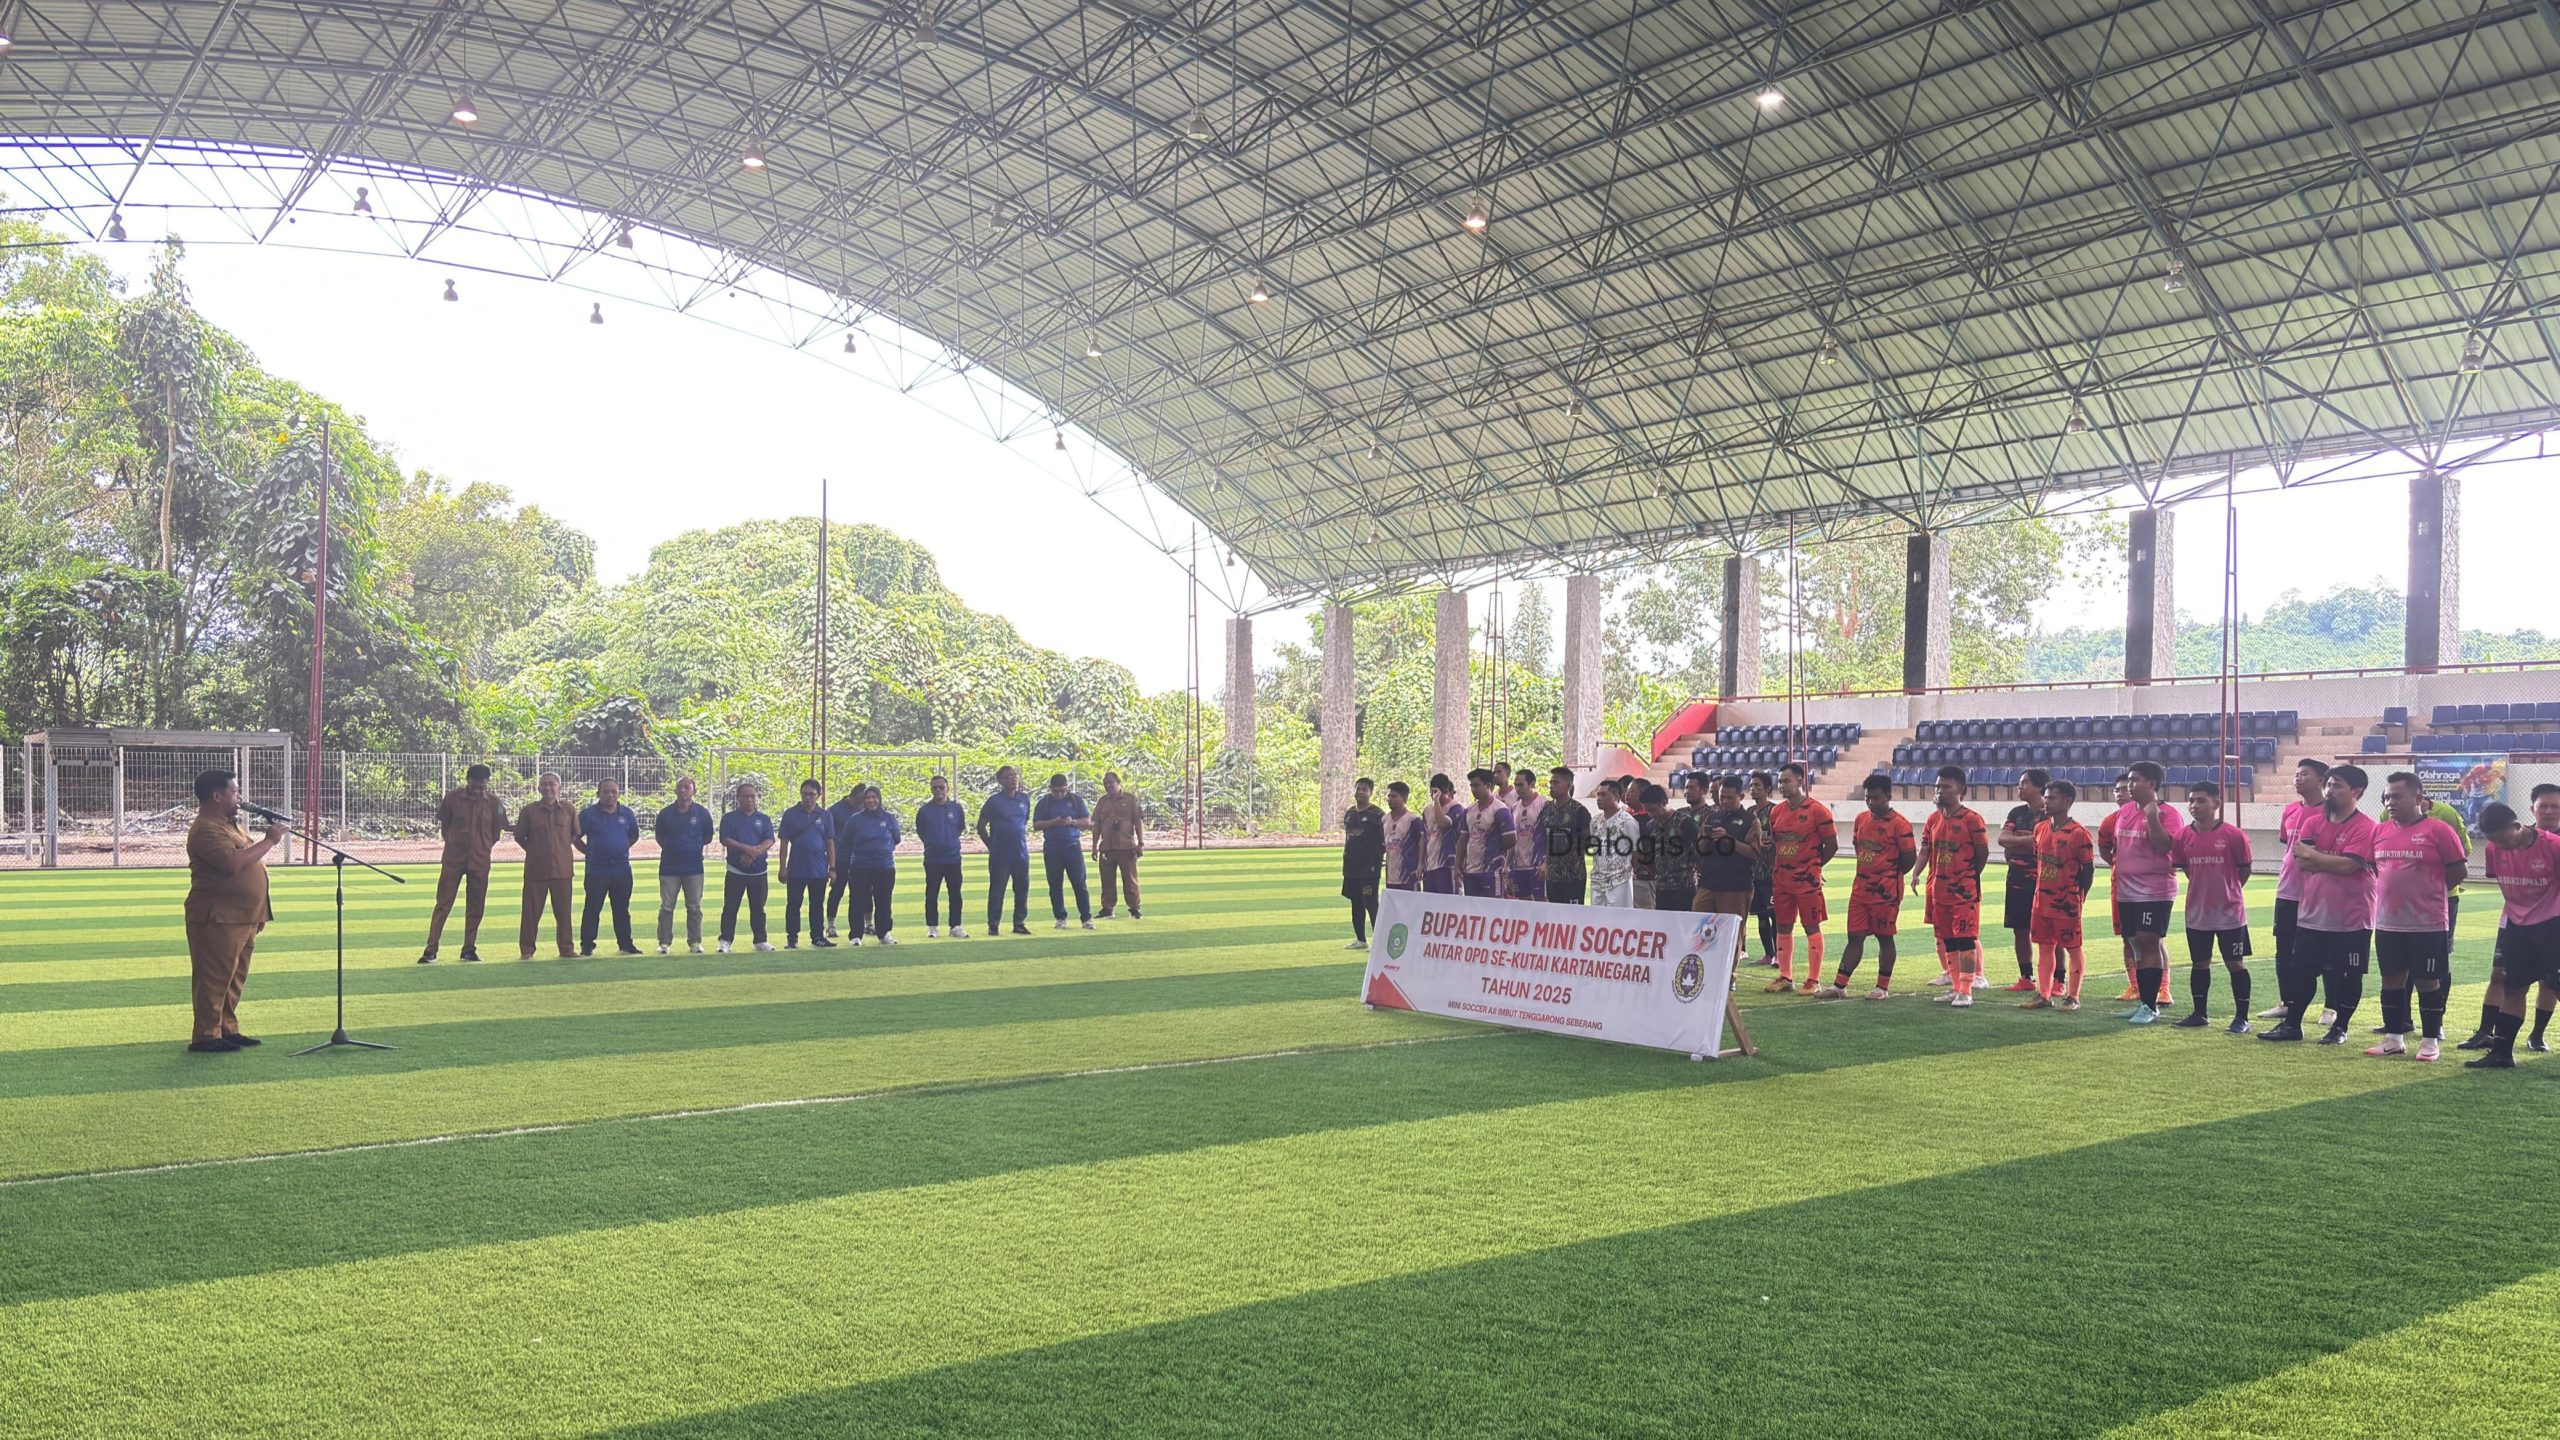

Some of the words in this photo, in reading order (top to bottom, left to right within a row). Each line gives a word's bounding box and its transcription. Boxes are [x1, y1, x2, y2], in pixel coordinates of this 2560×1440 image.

[2418, 770, 2461, 782] Olahraga
[2141, 911, 2153, 926] 15
[1420, 910, 1487, 942] BUPATI
[1488, 916, 1529, 945] CUP
[1531, 920, 1578, 951] MINI
[1579, 926, 1668, 960] SOCCER
[2060, 929, 2074, 943] 24
[1423, 942, 1463, 962] ANTAR
[1464, 946, 1489, 965] OPD
[1490, 949, 1549, 973] SE-KUTAI
[1551, 956, 1651, 984] KARTANEGARA
[2348, 952, 2360, 967] 10
[2426, 958, 2436, 972] 11
[1481, 976, 1531, 999] TAHUN
[1533, 983, 1572, 1005] 2025
[1447, 1000, 1462, 1009] MINI
[1462, 1002, 1488, 1014] SOCCER
[1488, 1006, 1497, 1015] AJI
[1498, 1007, 1518, 1018] IMBUT
[1518, 1010, 1566, 1025] TENGGARONG
[1565, 1018, 1603, 1031] SEBERANG
